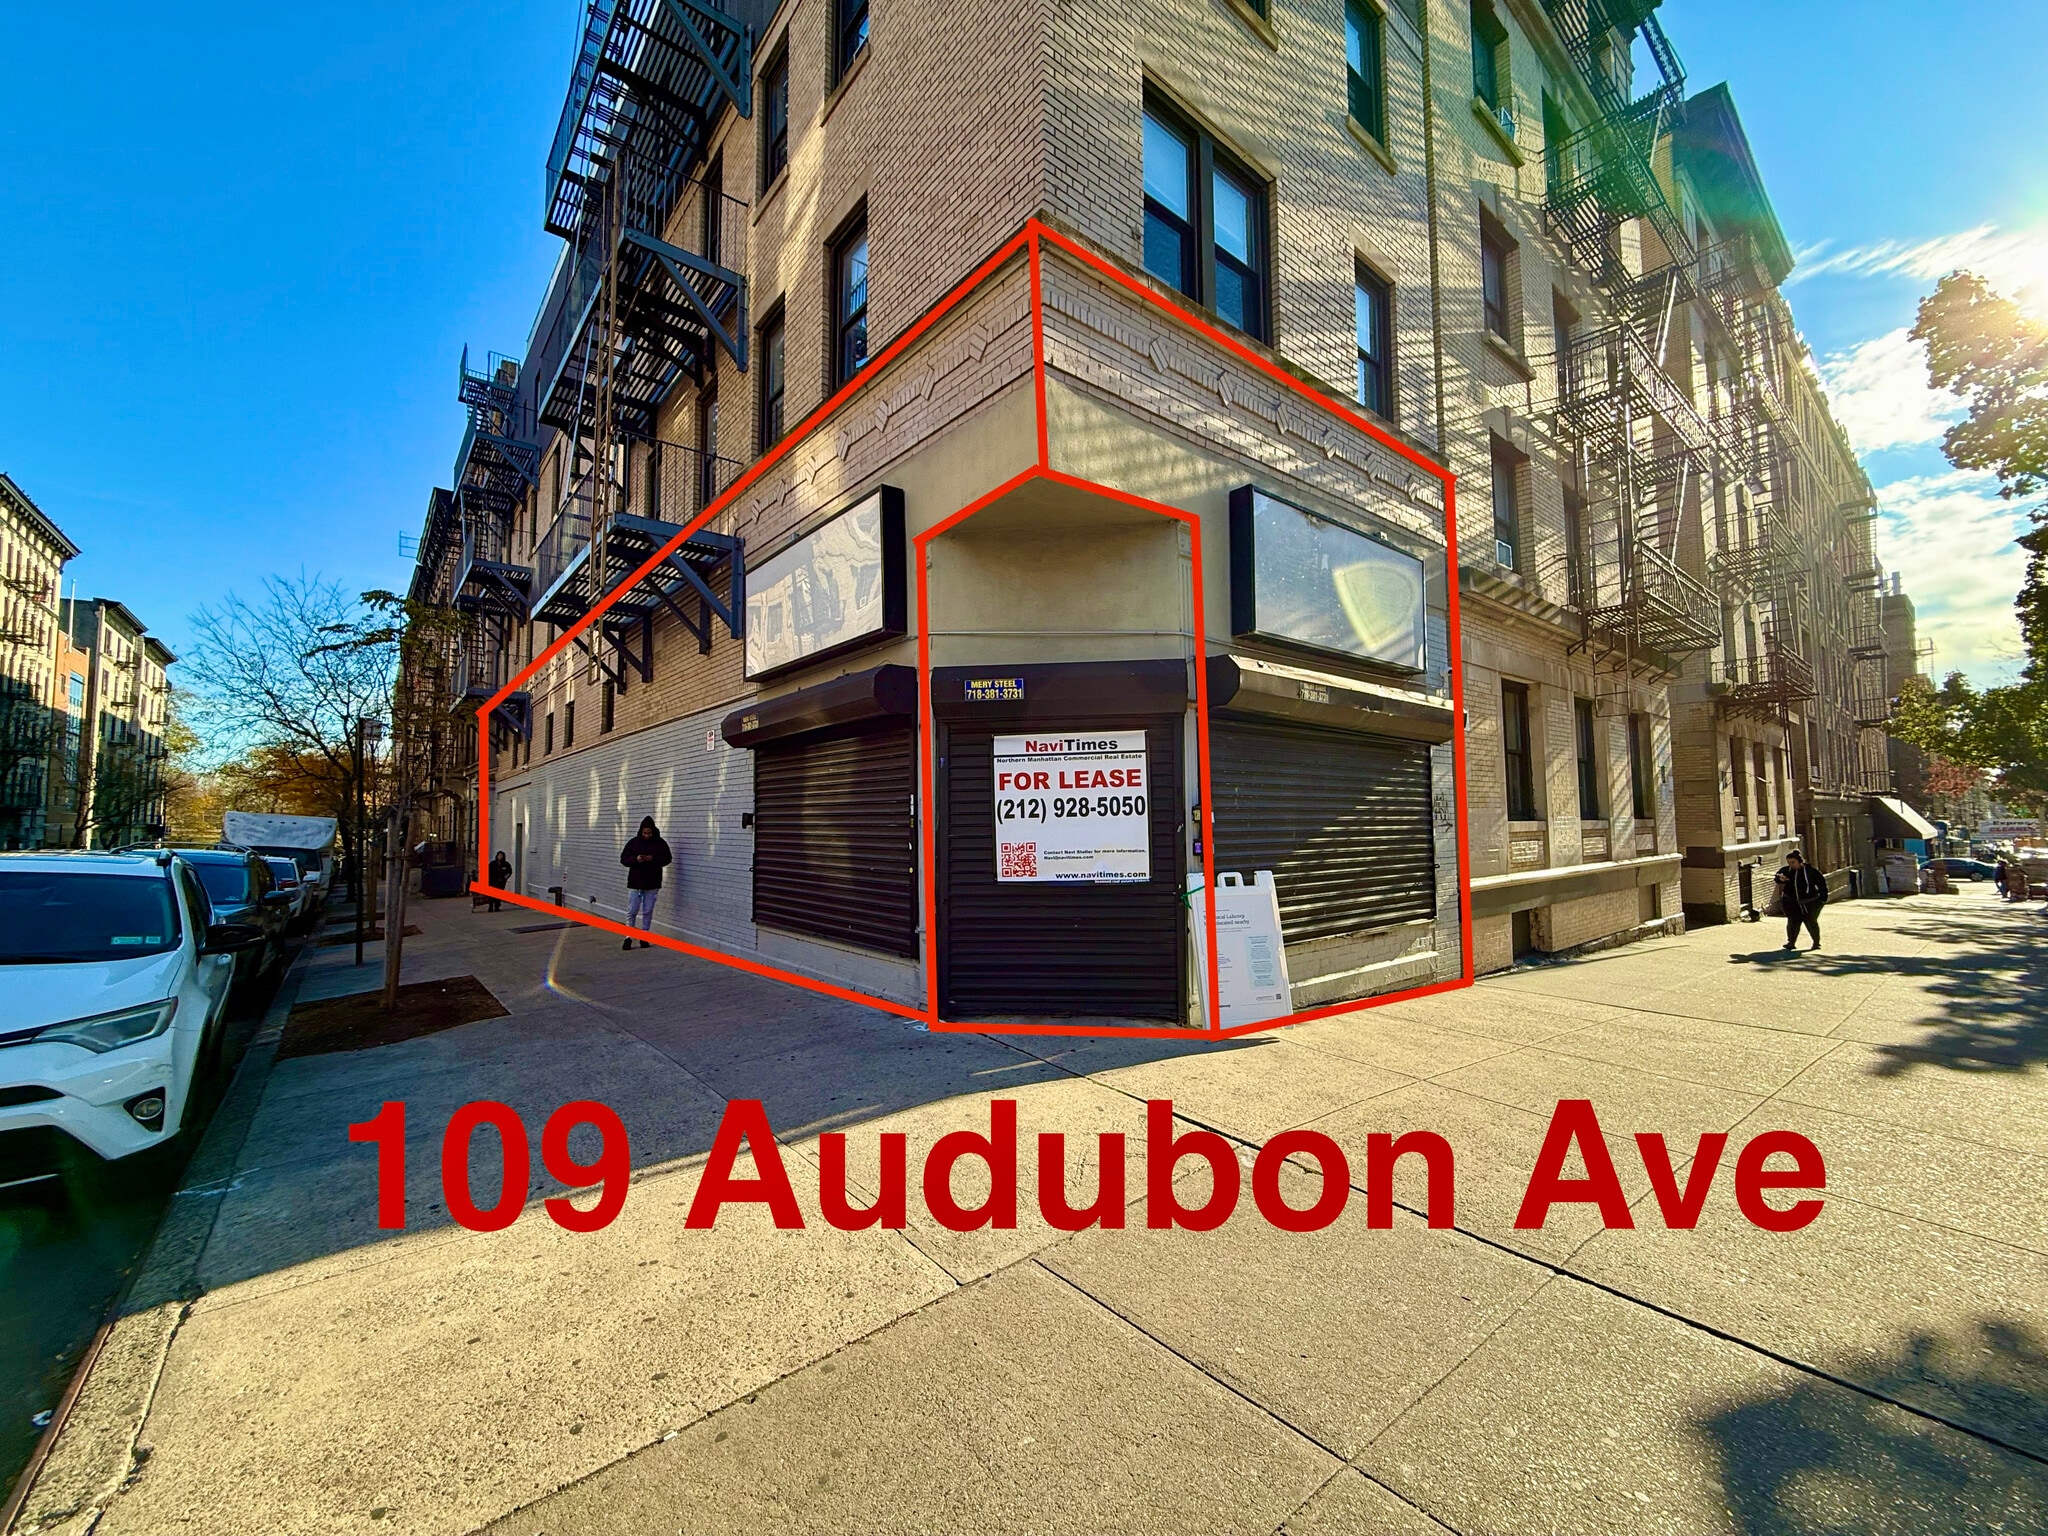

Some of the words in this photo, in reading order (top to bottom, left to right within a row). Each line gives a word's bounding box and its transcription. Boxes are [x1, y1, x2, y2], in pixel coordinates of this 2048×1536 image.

[971, 680, 993, 689] MERY
[994, 679, 1017, 688] STEEL
[966, 688, 1022, 700] 718-381-3731
[1025, 738, 1119, 753] NaviTimes
[1063, 754, 1103, 762] Commercial
[999, 772, 1050, 791] FOR
[1059, 768, 1142, 789] LEASE
[996, 797, 1047, 825] (212)
[1053, 795, 1146, 818] 928-5050
[1055, 870, 1147, 879] www.navitimes.com
